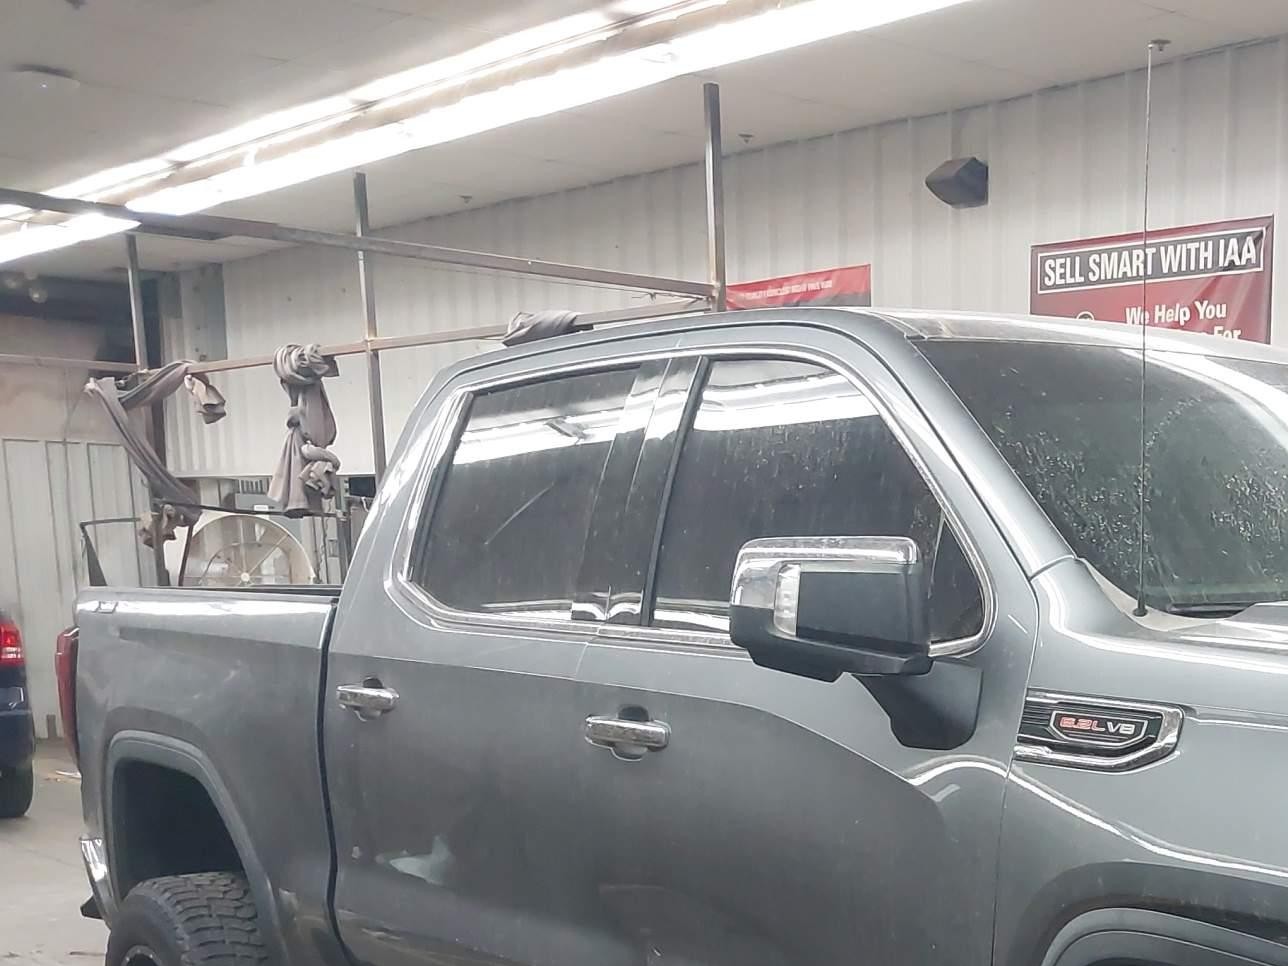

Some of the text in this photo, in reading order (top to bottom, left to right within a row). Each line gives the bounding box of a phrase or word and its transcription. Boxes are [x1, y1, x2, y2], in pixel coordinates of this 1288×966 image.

[1044, 236, 1256, 286] SELL SMART WITH IAA
[1125, 301, 1226, 325] We Help You
